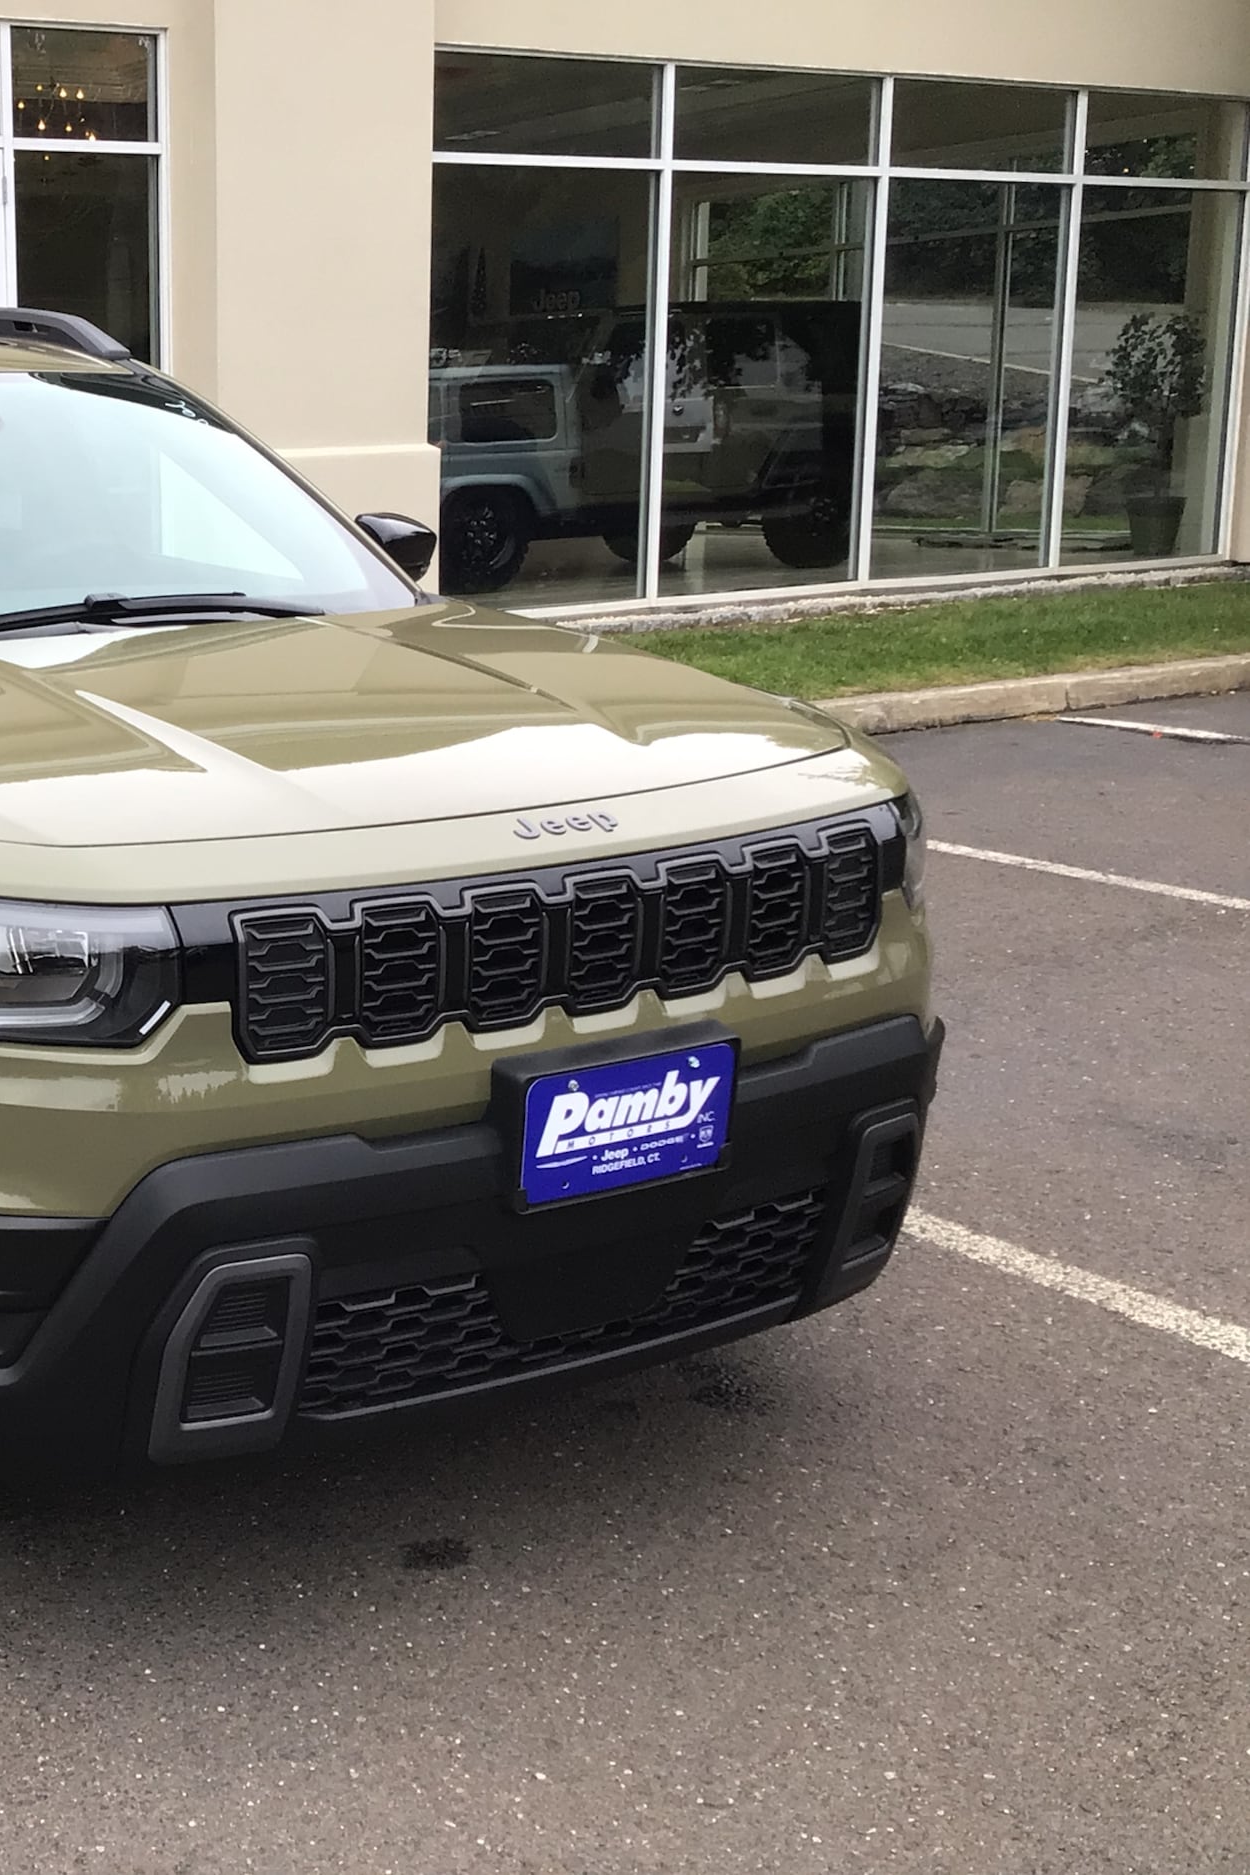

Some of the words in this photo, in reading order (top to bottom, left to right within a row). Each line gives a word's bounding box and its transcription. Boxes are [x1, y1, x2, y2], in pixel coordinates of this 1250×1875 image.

[532, 287, 581, 312] Jeep
[513, 811, 619, 840] Jeep
[536, 1070, 721, 1158] Pamby
[565, 1120, 672, 1150] MOTORS
[601, 1148, 630, 1162] Jeep
[640, 1136, 685, 1151] DODGE
